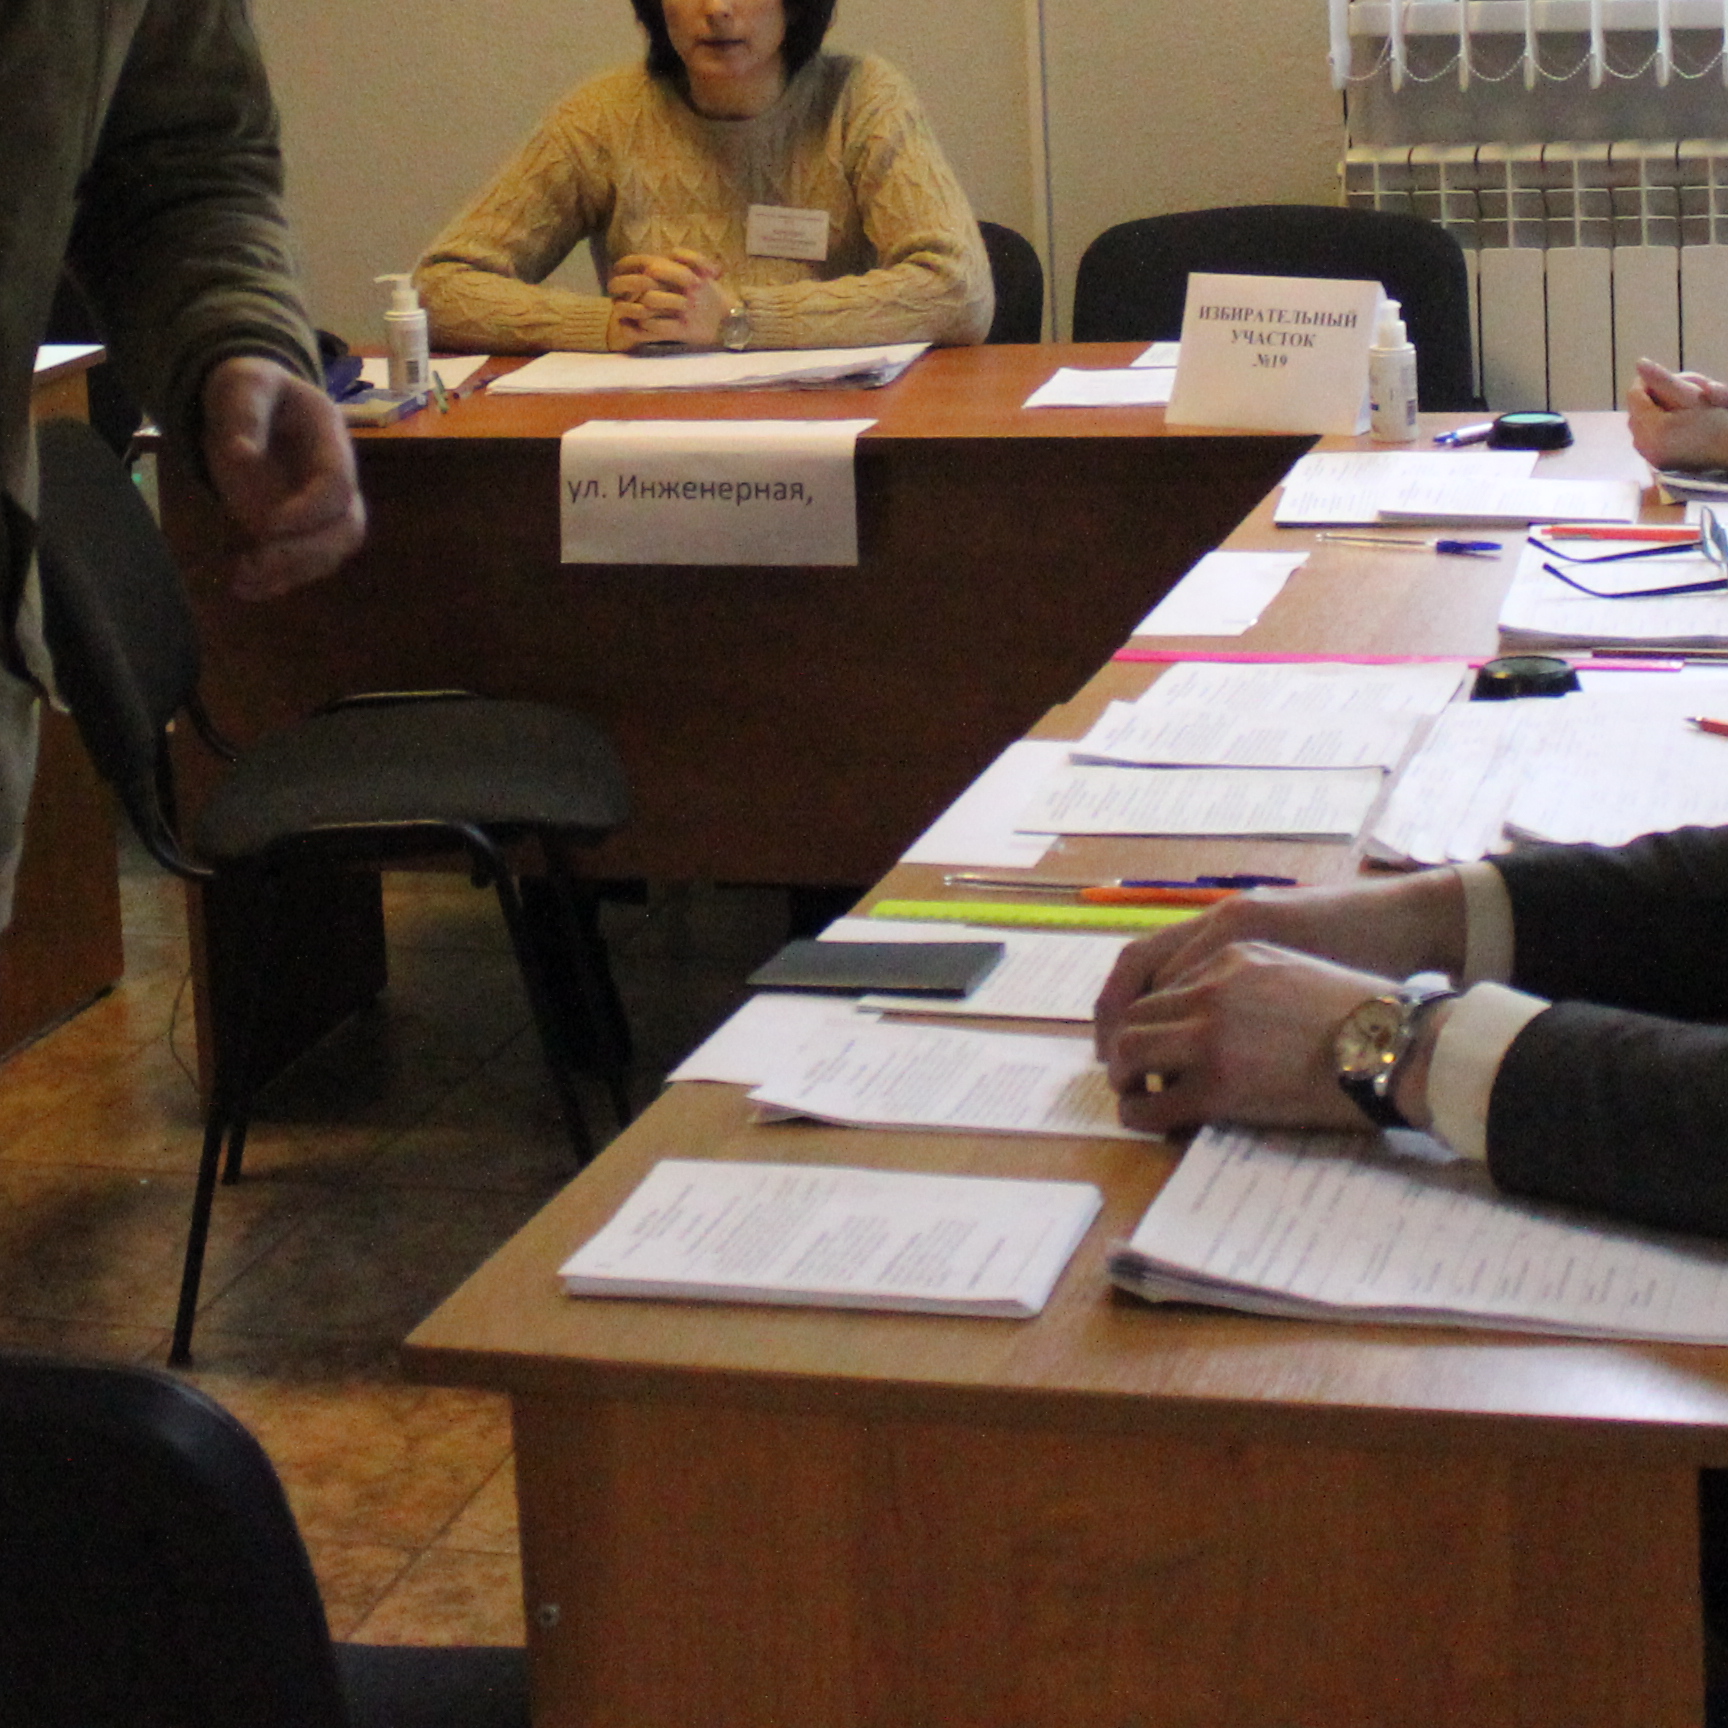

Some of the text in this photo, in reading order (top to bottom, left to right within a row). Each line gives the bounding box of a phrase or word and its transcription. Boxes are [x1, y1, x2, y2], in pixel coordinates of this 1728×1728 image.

[1199, 305, 1359, 329] ИЗБИРАТЕЛЬНЫЙ
[1230, 329, 1317, 348] УЧАСТОК
[567, 474, 814, 507] ул. Инженерная,
